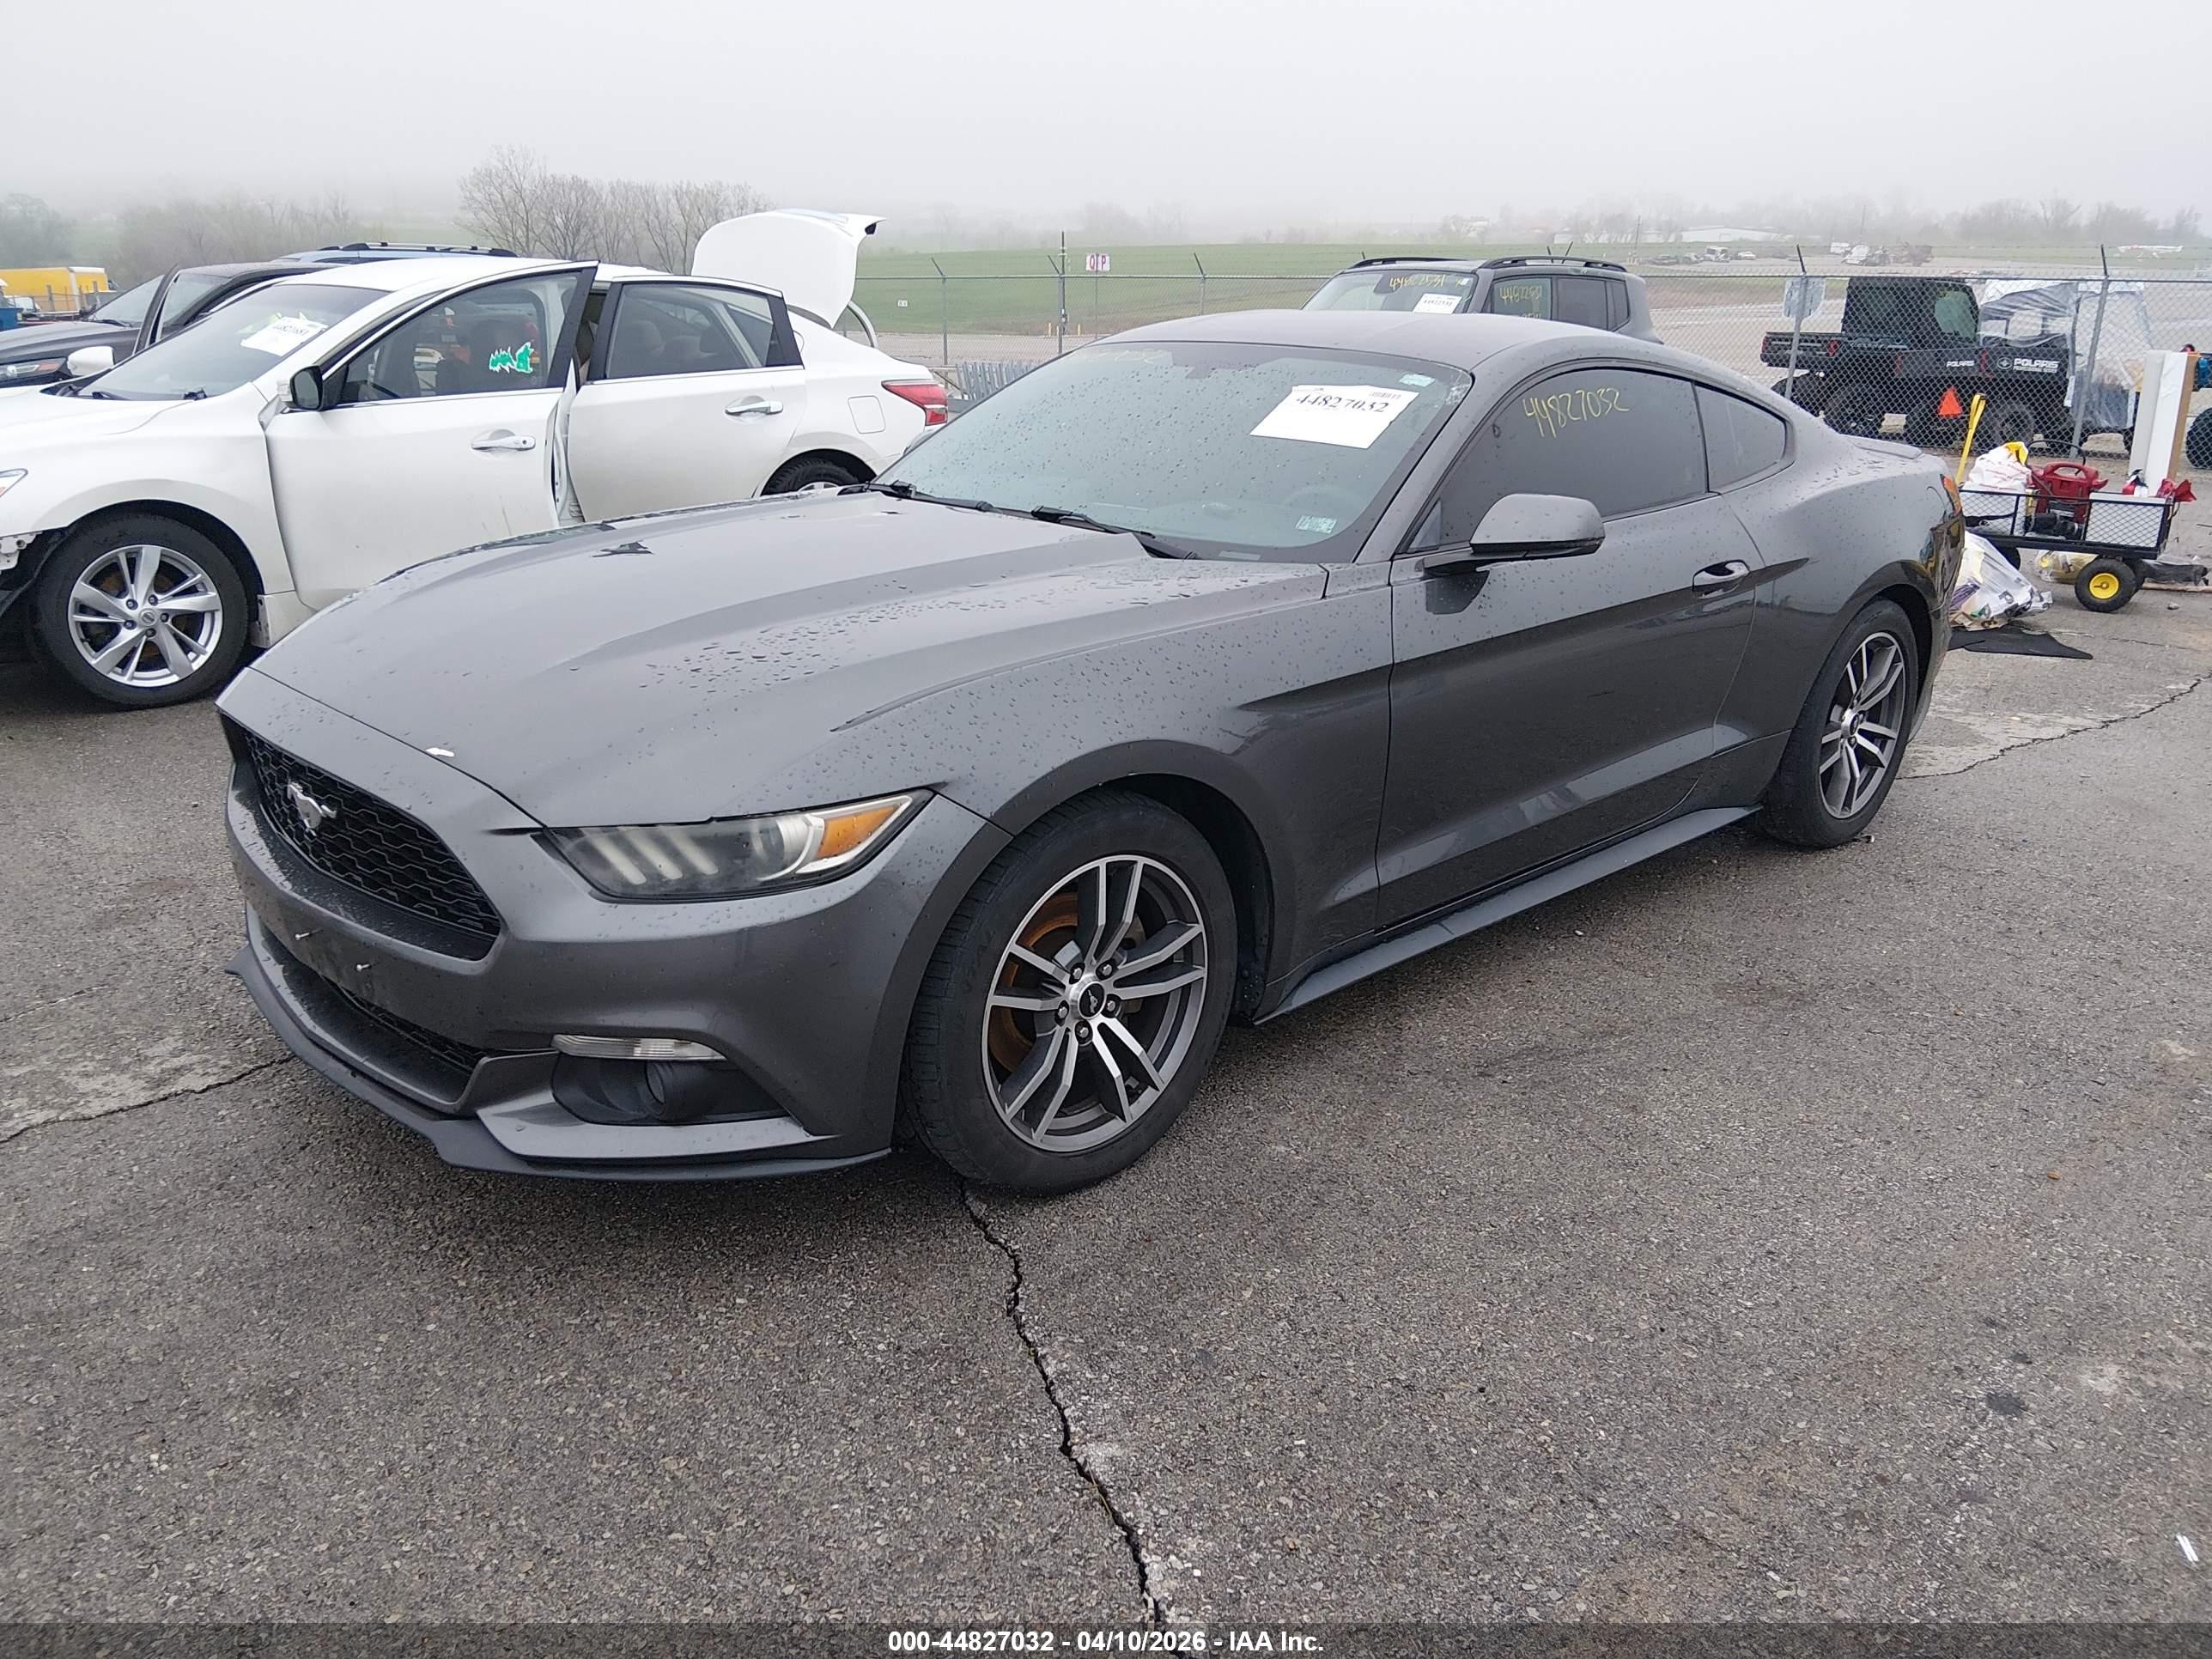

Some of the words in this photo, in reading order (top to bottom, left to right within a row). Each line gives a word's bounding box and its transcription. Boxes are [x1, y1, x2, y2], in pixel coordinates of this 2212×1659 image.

[2014, 358, 2060, 368] POLARIS
[1296, 393, 1390, 413] 44827032
[1522, 387, 1630, 439] 44827032
